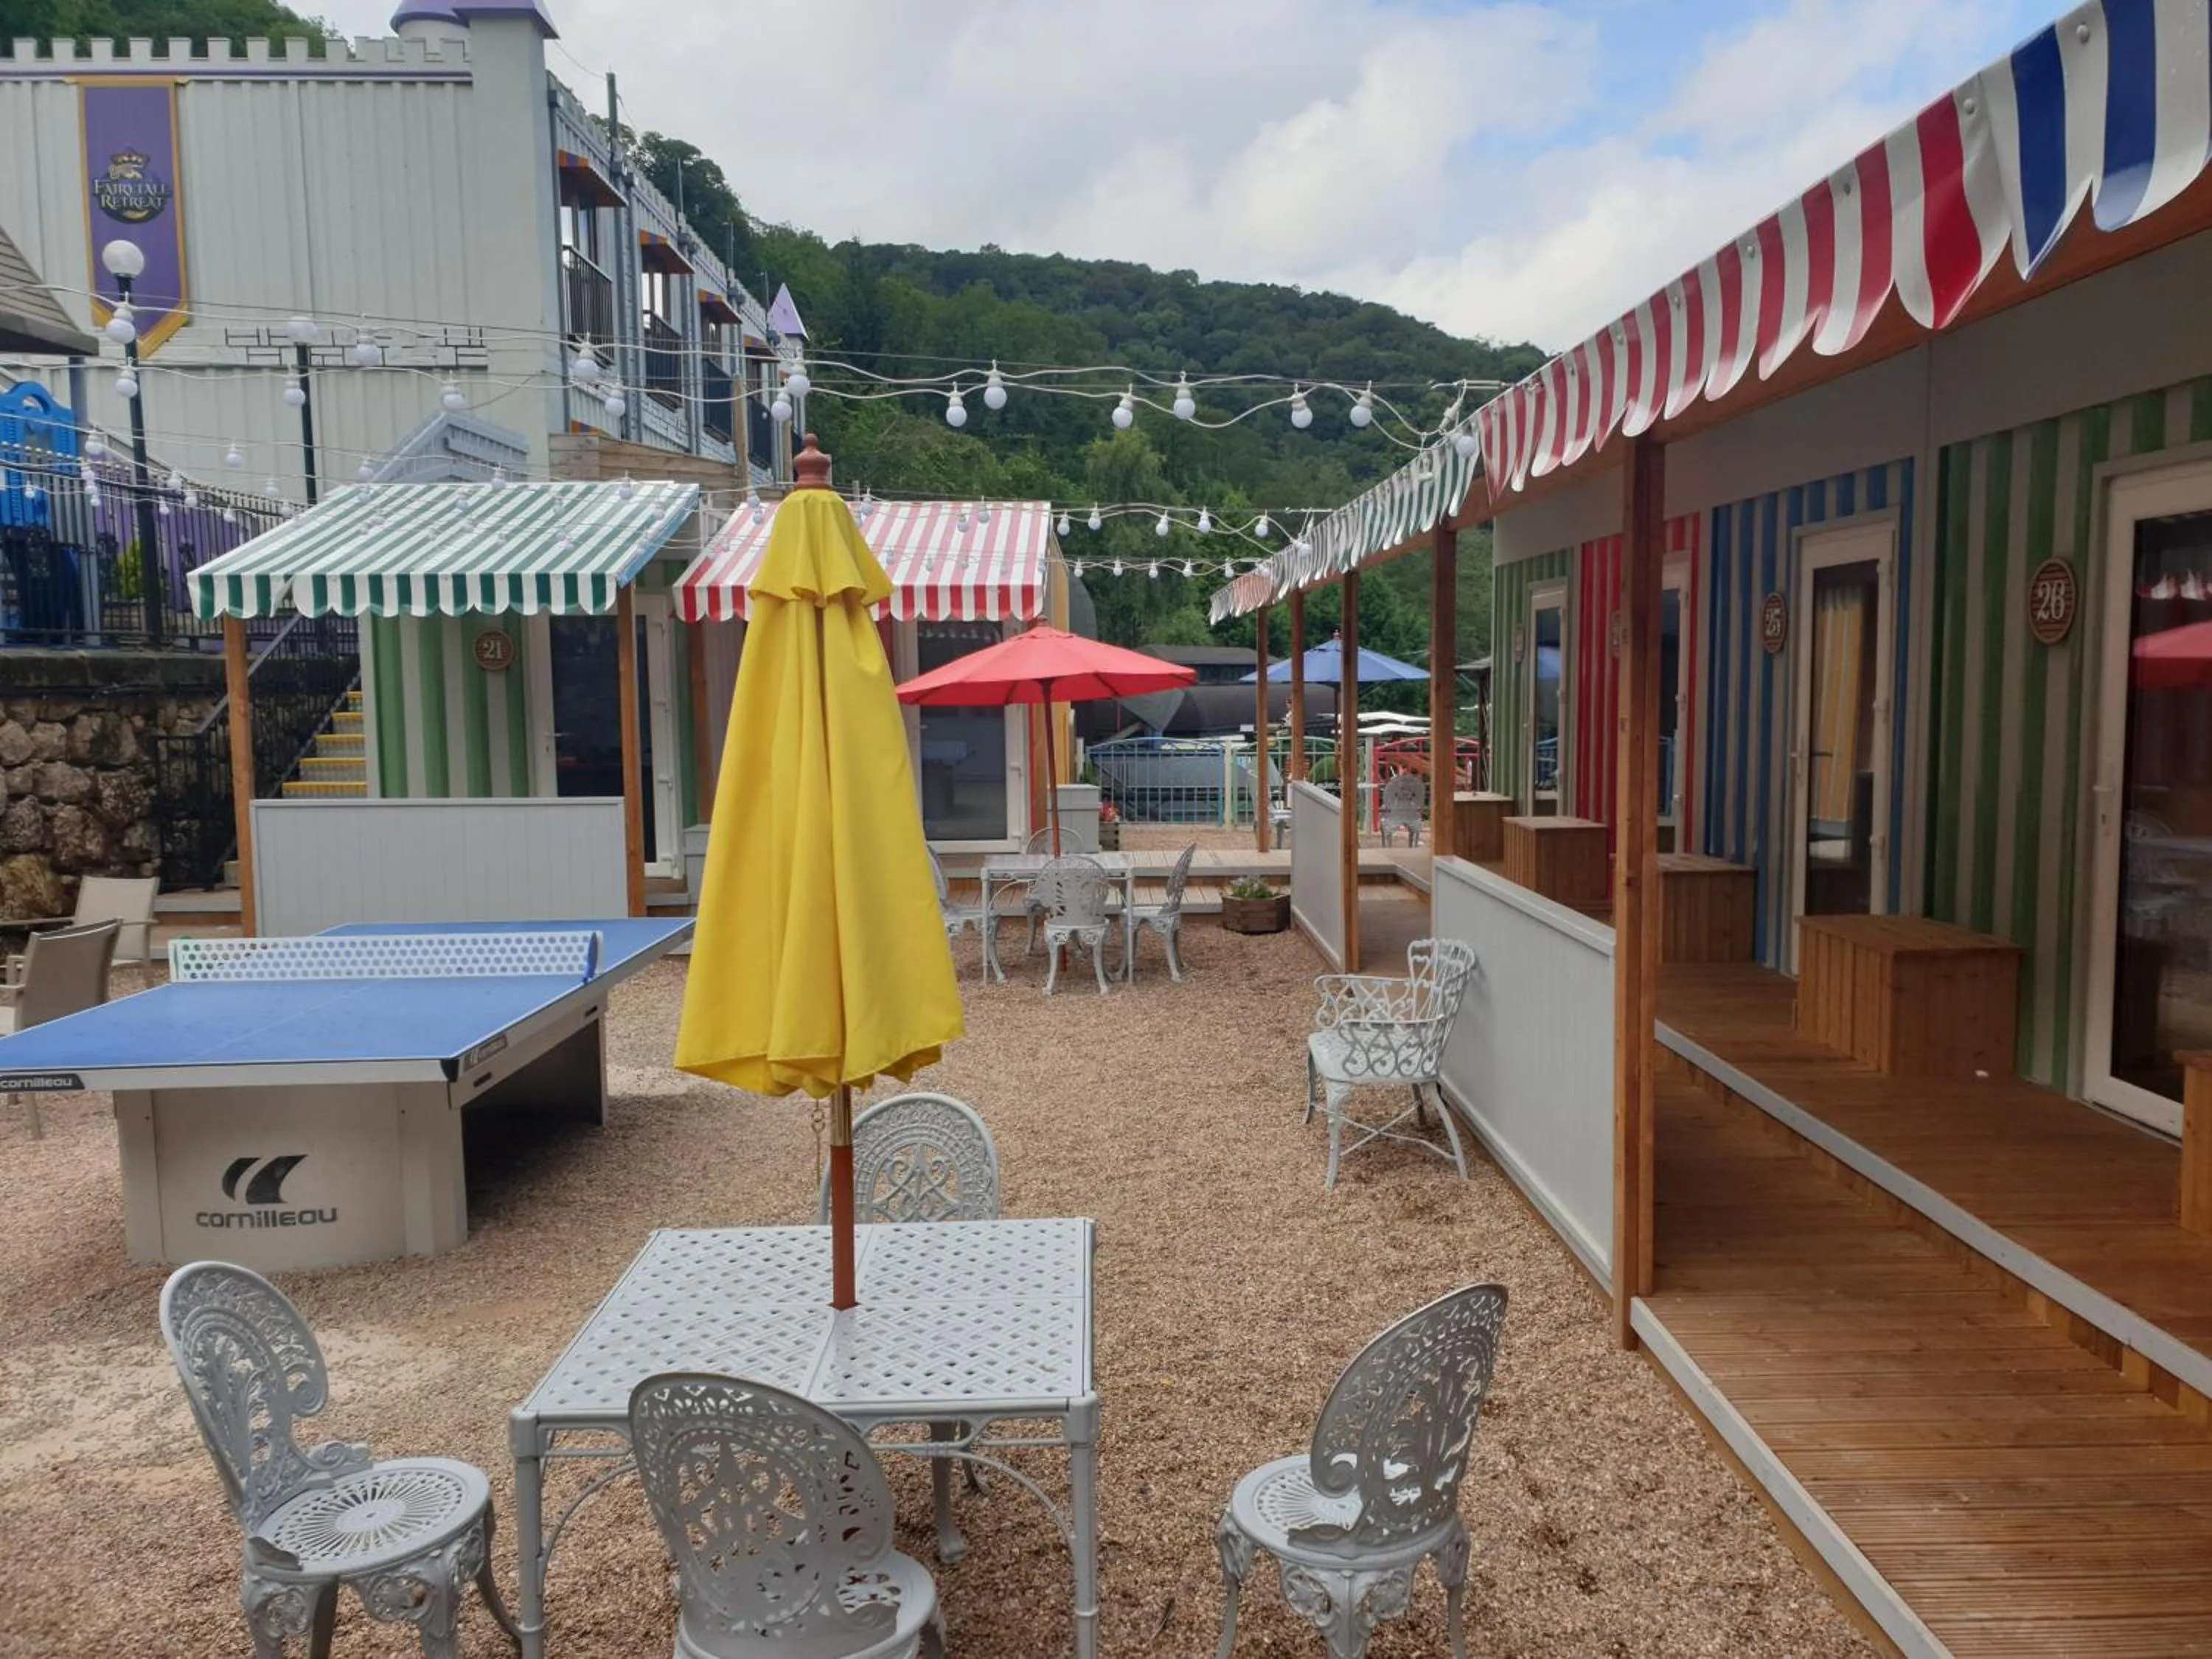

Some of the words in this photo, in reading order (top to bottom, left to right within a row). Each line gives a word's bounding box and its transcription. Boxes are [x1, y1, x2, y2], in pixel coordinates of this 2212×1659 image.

[100, 194, 165, 210] RETREAT
[482, 639, 504, 660] 21
[0, 1077, 72, 1088] cornilleau
[195, 1207, 338, 1229] cornilleau
